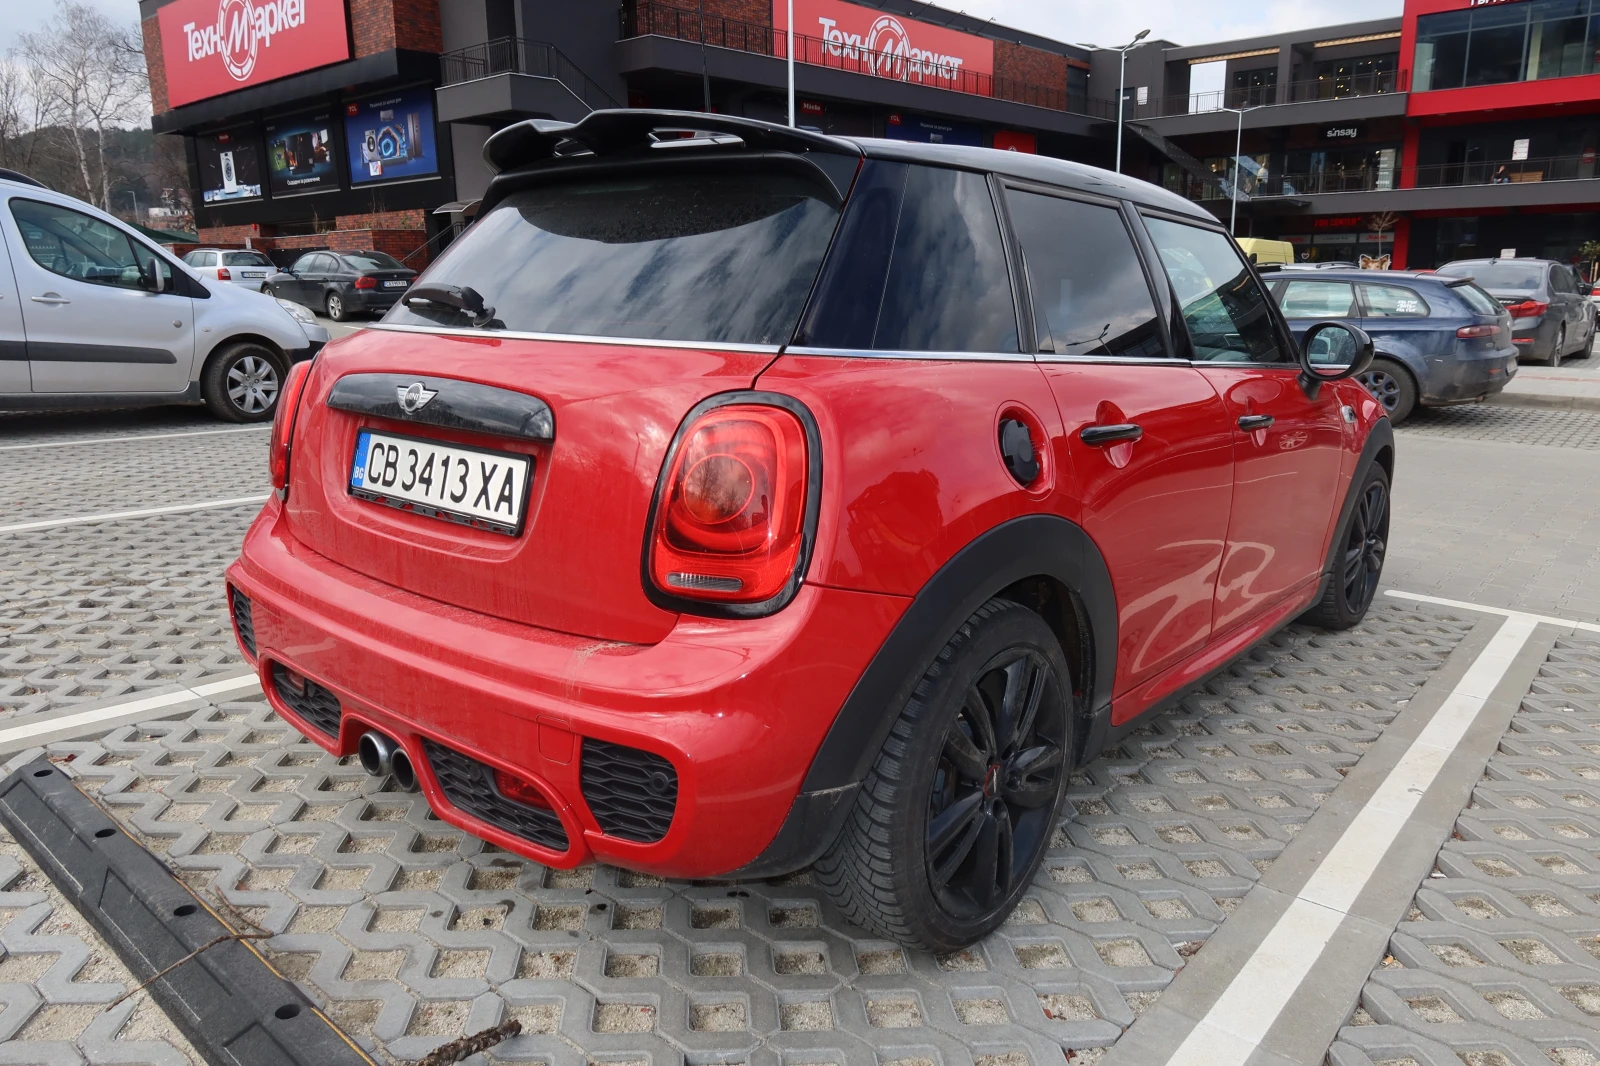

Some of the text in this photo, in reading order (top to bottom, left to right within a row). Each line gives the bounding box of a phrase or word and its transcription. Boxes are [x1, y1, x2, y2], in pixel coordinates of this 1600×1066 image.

[1327, 128, 1357, 138] sinsay
[406, 391, 420, 401] MINI
[354, 466, 365, 480] BG
